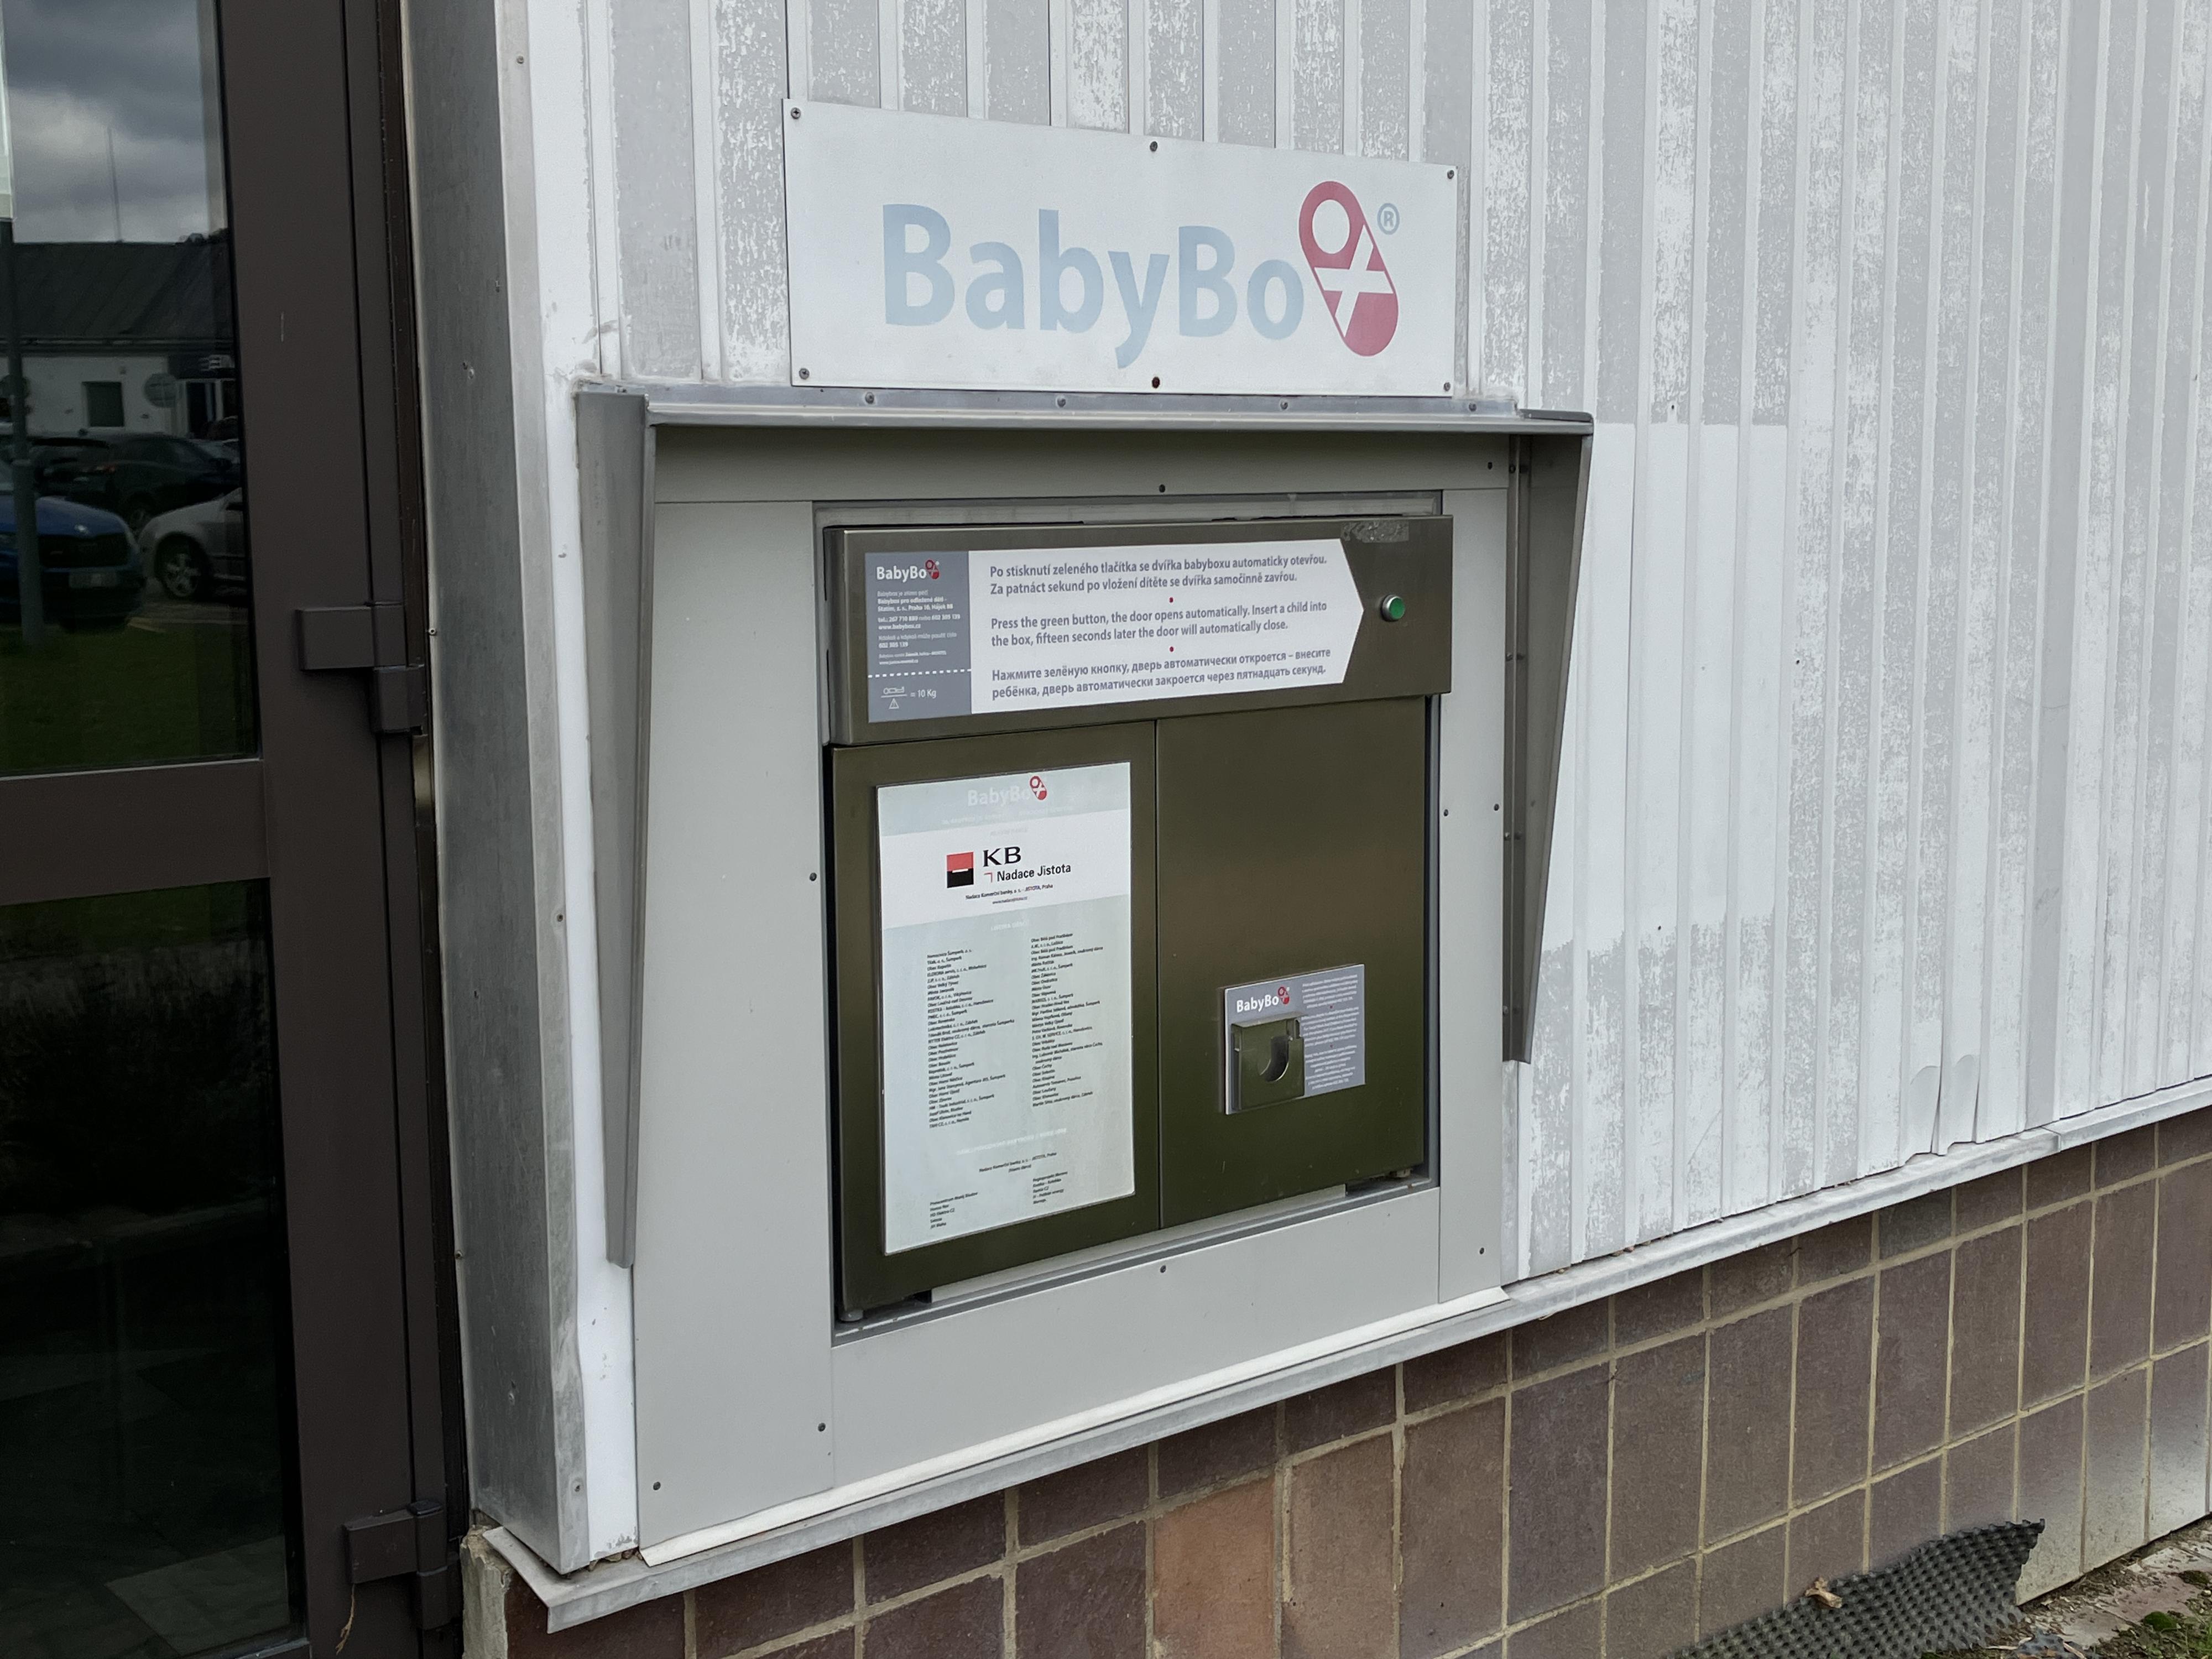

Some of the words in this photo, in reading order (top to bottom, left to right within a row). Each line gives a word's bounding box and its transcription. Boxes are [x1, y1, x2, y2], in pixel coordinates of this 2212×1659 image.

[990, 566, 1004, 578] Po
[1006, 563, 1051, 577] stisknutí
[1052, 562, 1099, 576] zeleného
[1100, 560, 1137, 574] tlačítka
[1139, 562, 1150, 572] se
[1151, 559, 1182, 571] dvířka
[1184, 557, 1230, 570] babyboxu
[1232, 555, 1289, 568] automaticky
[1290, 554, 1327, 566] otevřou.
[990, 583, 1004, 596] Za
[1006, 581, 1046, 597] patnáct
[1047, 578, 1085, 593] sekund
[1087, 581, 1100, 593] po
[1102, 576, 1138, 591] vložení
[1139, 576, 1168, 589] dítěte
[1170, 578, 1180, 587] se
[1182, 574, 1212, 587] dvířka
[1213, 571, 1263, 586] samočinně
[1264, 570, 1297, 583] zavřou.
[991, 618, 1019, 630] Press
[1020, 616, 1038, 628] the
[1040, 617, 1070, 630] green
[1072, 613, 1109, 625] button,
[1111, 611, 1128, 624] the
[1129, 610, 1153, 622] door
[1154, 611, 1184, 622] opens
[1185, 604, 1250, 619] automatically.
[1252, 604, 1278, 615] Insert
[1279, 605, 1285, 614] a
[1286, 601, 1308, 613] child
[1310, 601, 1327, 612] into
[991, 635, 1009, 647] the
[1011, 634, 1034, 647] box,
[1035, 632, 1070, 645] fifteen
[1072, 628, 1112, 643] seconds
[1114, 628, 1136, 640] later
[1138, 626, 1155, 639] the
[1156, 625, 1180, 637] door
[1181, 623, 1198, 636] will
[1199, 619, 1262, 635] automatically
[1263, 618, 1288, 631] close.
[992, 669, 1042, 682] Нажмите
[1044, 666, 1088, 679] зелёную
[1091, 663, 1130, 675] кнопку,
[1131, 661, 1162, 674] дверь
[1164, 656, 1237, 670] автоматически
[1239, 652, 1286, 665] откроется
[1295, 649, 1331, 660] внесите
[917, 690, 926, 698] 10
[927, 689, 937, 698] Kg
[992, 686, 1040, 701] ребёнка,
[1042, 684, 1074, 697] дверь
[1076, 678, 1154, 692] автоматически
[1155, 674, 1205, 687] закроется
[1207, 672, 1235, 684] через
[1237, 667, 1291, 680] пятнадцать
[1292, 665, 1326, 677] секунд.
[982, 846, 1022, 868] KB
[997, 868, 1035, 883] Nadace
[1037, 863, 1071, 877] Jistota
